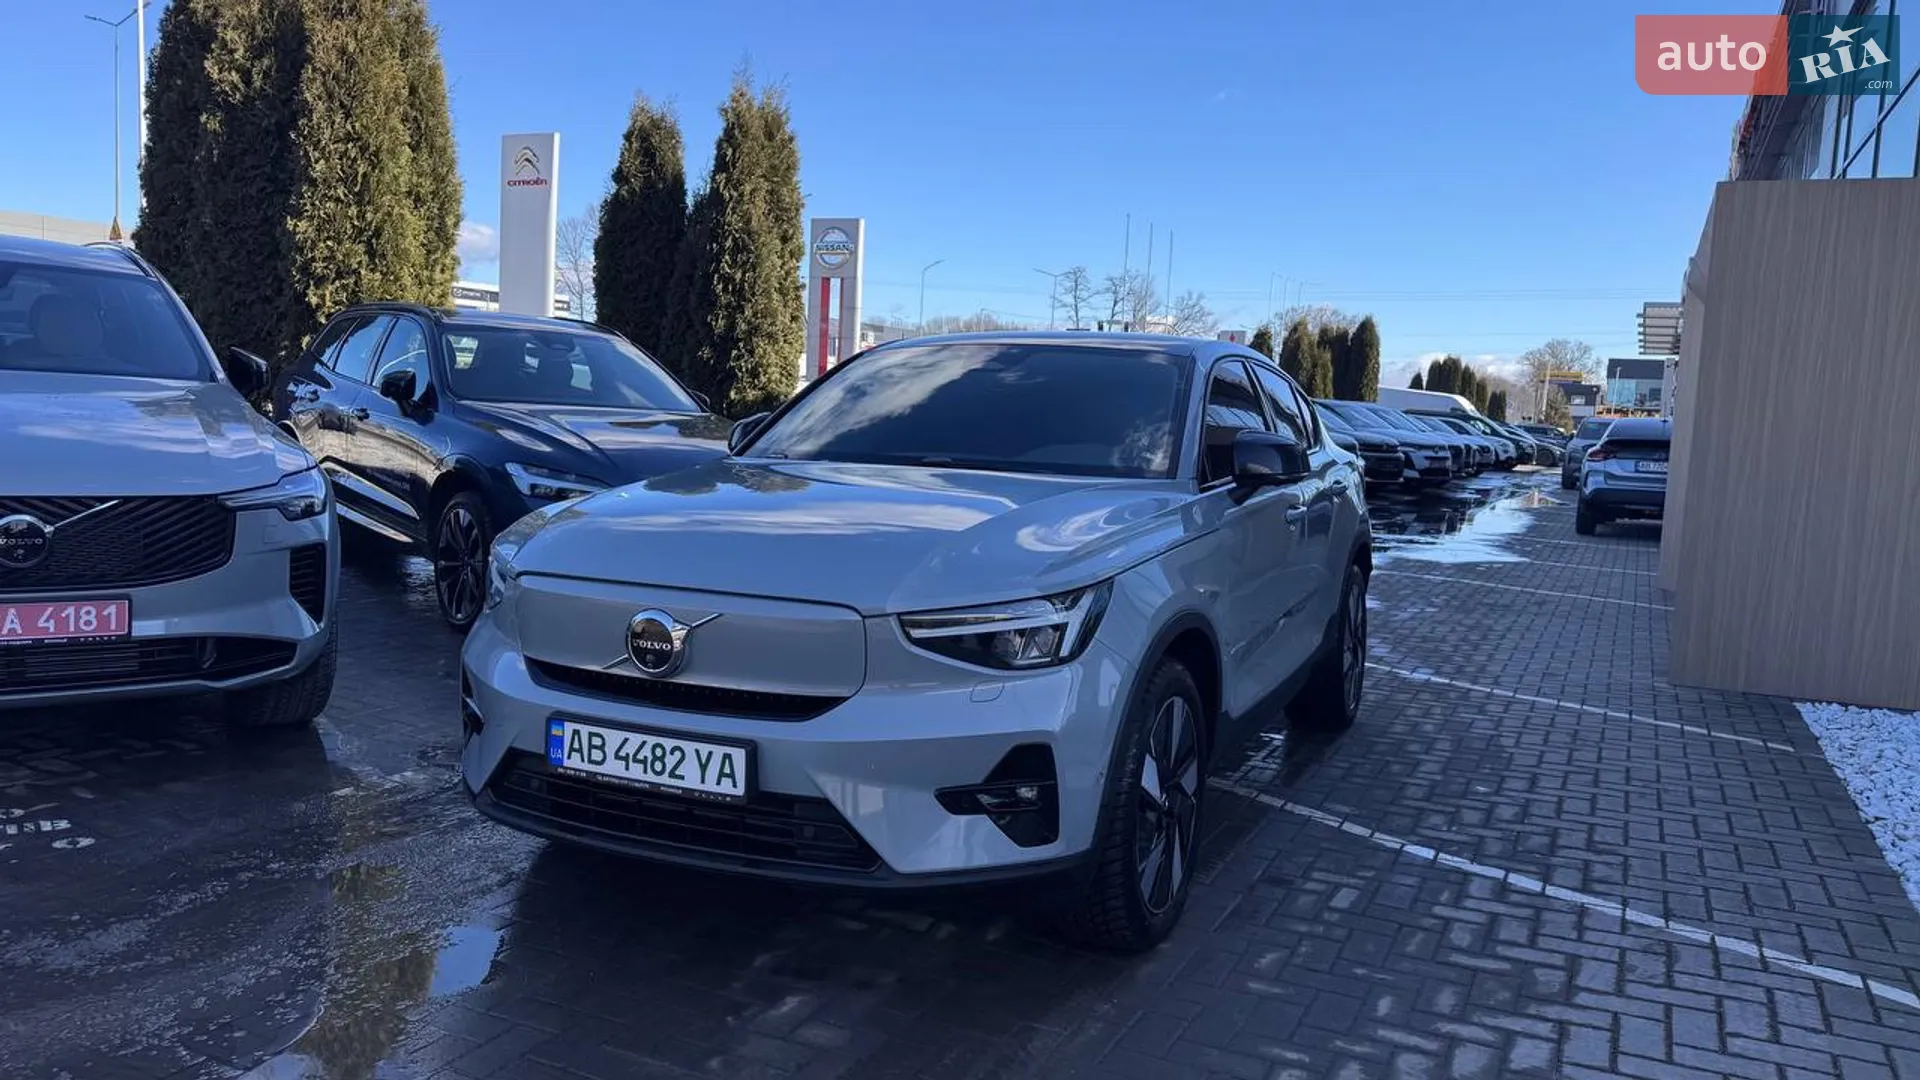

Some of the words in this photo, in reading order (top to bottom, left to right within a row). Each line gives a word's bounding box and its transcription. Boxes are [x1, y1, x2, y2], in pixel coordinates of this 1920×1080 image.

[815, 243, 851, 252] NISSAN
[37, 604, 118, 633] 4181
[632, 638, 671, 651] VOLVO
[550, 746, 563, 760] UA
[566, 728, 607, 766] AB
[613, 736, 687, 780] 4482
[693, 747, 738, 789] YA
